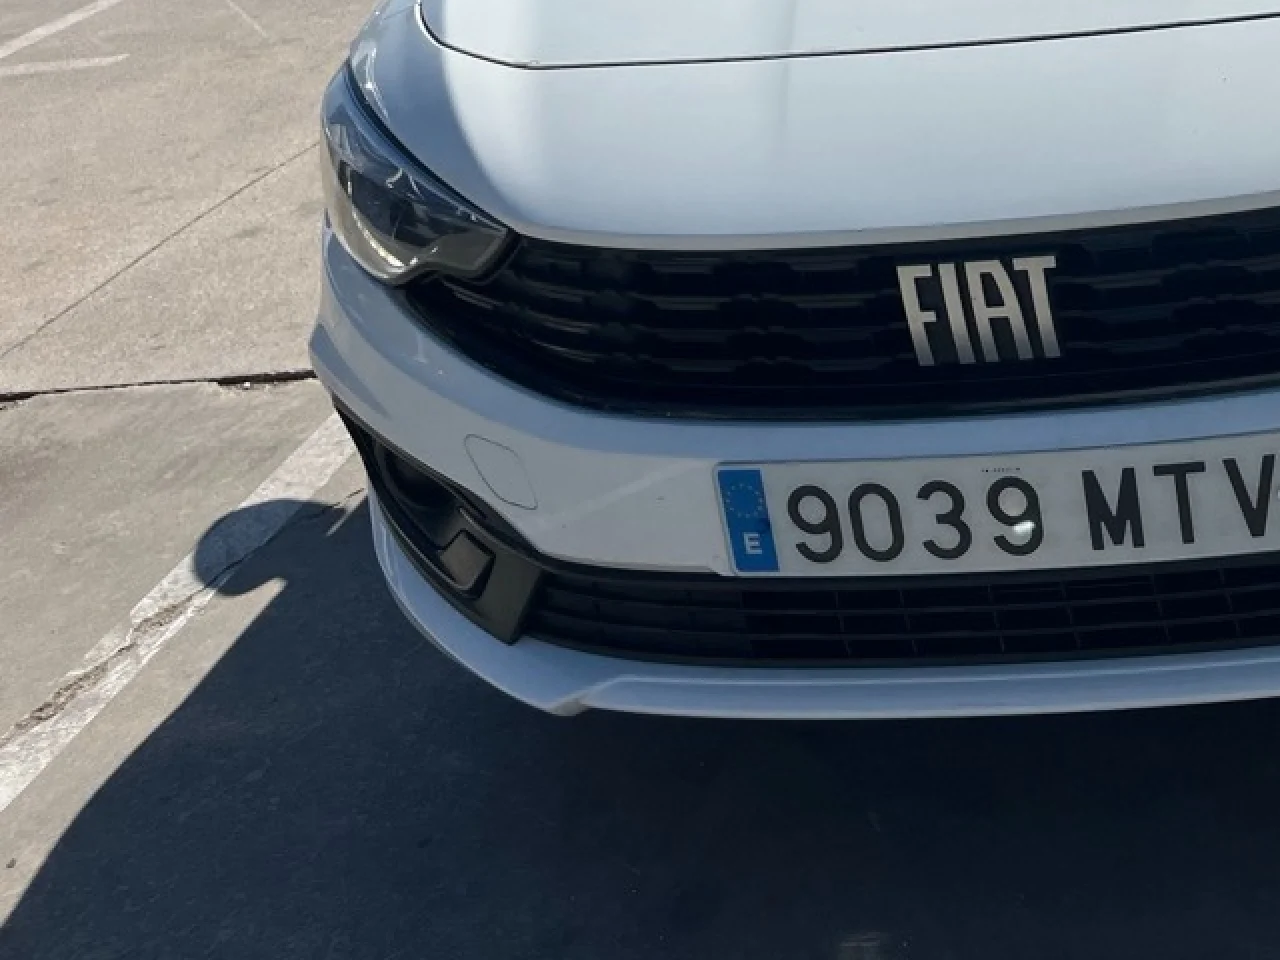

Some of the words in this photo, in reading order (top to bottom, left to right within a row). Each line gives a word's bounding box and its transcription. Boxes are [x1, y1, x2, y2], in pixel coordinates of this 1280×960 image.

[897, 255, 1061, 366] FIAT
[744, 532, 763, 555] E
[787, 476, 1044, 564] 9039
[1082, 453, 1276, 550] MTV
